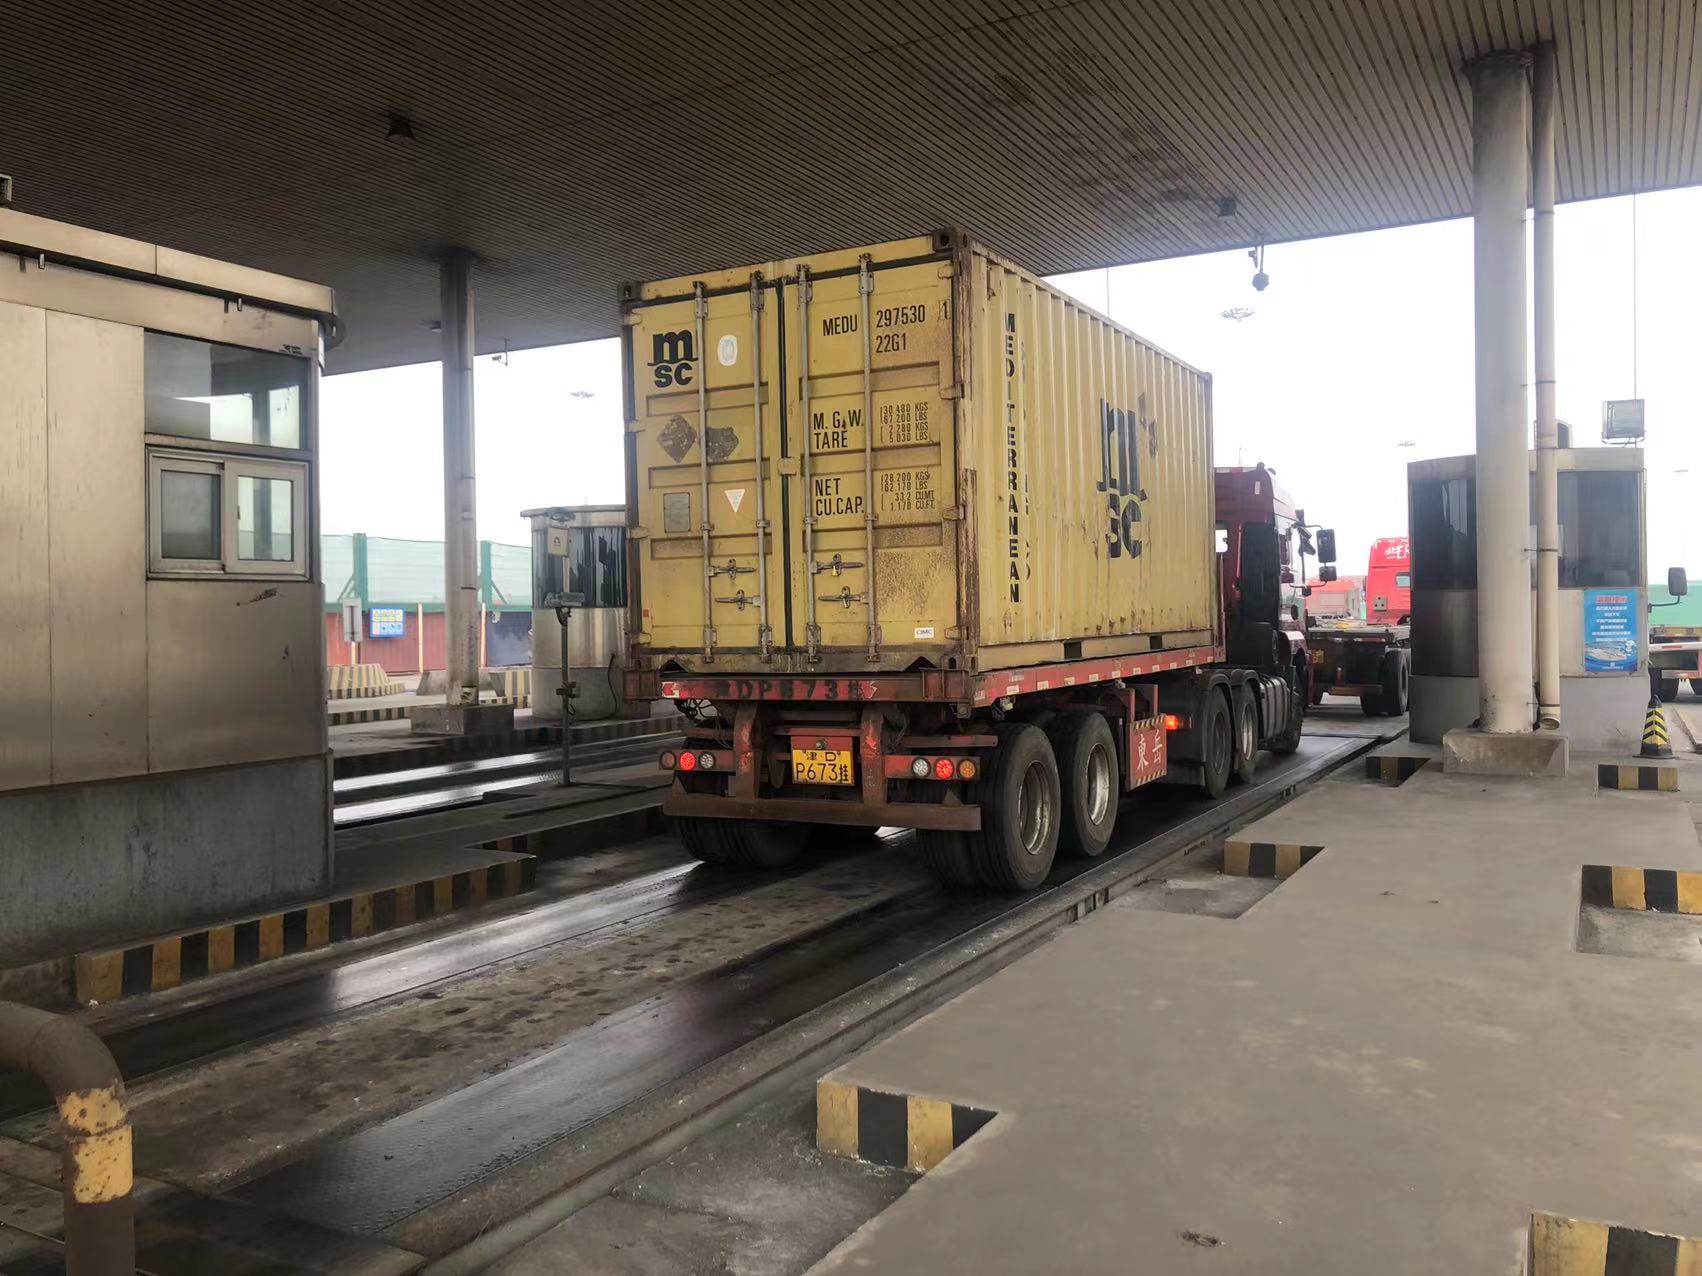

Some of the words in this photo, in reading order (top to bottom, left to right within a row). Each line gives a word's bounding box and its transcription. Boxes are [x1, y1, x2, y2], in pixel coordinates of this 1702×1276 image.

[823, 314, 858, 336] MEDU
[876, 304, 926, 328] 297530
[875, 332, 907, 353] 22G1
[814, 431, 848, 450] TARE
[915, 431, 928, 441] LBS
[915, 470, 929, 481] KGS
[915, 480, 928, 490] LBS
[815, 478, 841, 497] NET
[815, 496, 864, 516] CU.CAP.
